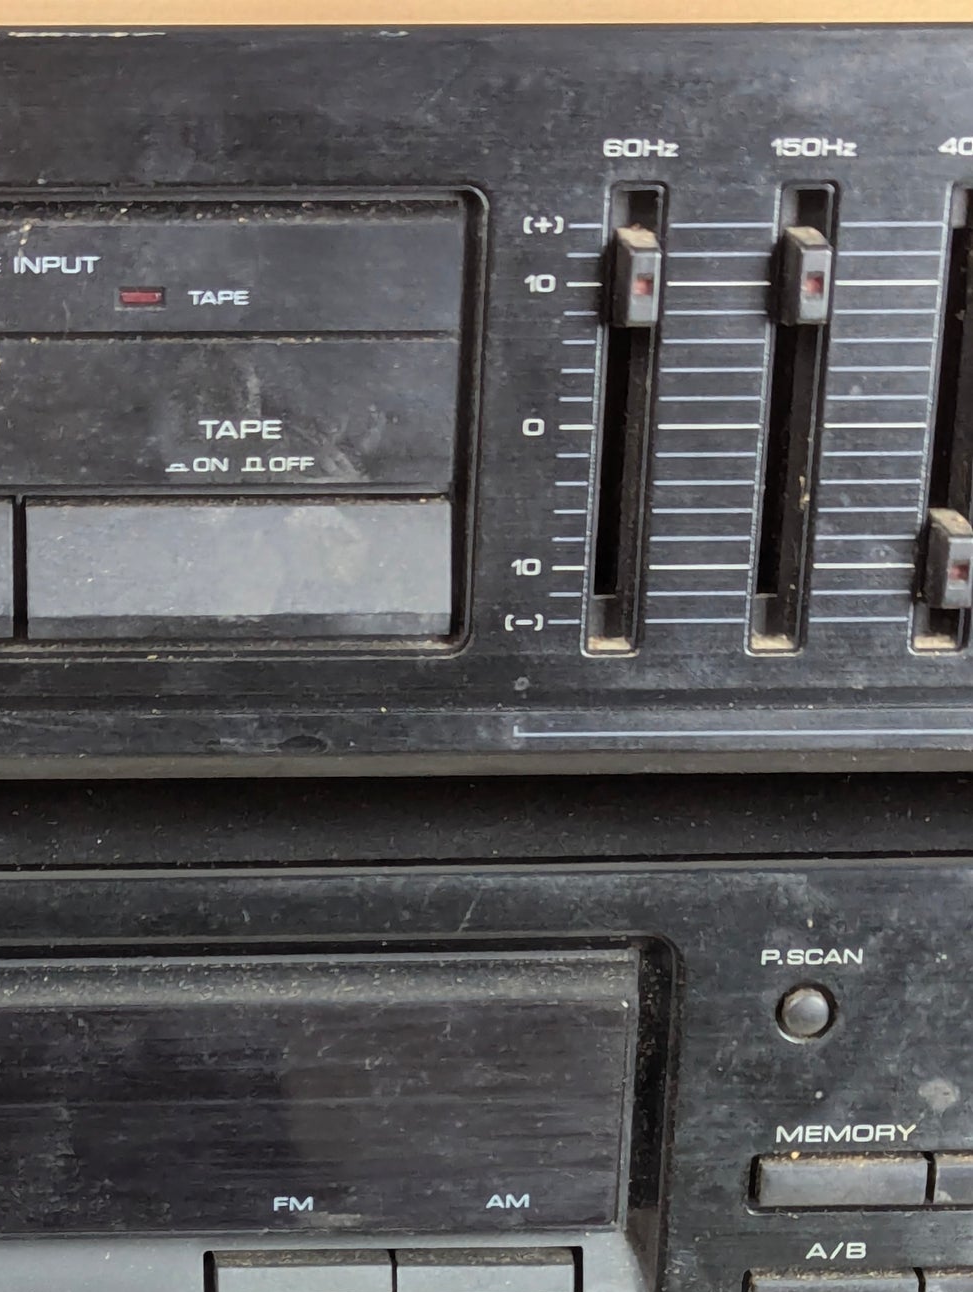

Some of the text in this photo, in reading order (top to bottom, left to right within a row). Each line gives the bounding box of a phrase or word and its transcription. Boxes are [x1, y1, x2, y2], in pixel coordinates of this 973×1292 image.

[602, 138, 680, 158] 60Hz
[770, 137, 858, 157] 150Hz
[13, 254, 101, 274] INPUT
[524, 274, 557, 293] 10
[187, 290, 250, 306] TAPE
[198, 419, 283, 440] TAPE
[522, 418, 545, 437] 0
[192, 456, 315, 473] ON OFF
[510, 558, 542, 576] 10
[760, 948, 864, 966] P.SCAN
[775, 1123, 917, 1143] MEMORY
[273, 1196, 314, 1212] FM
[485, 1193, 530, 1209] AM
[805, 1241, 867, 1260] A/B
